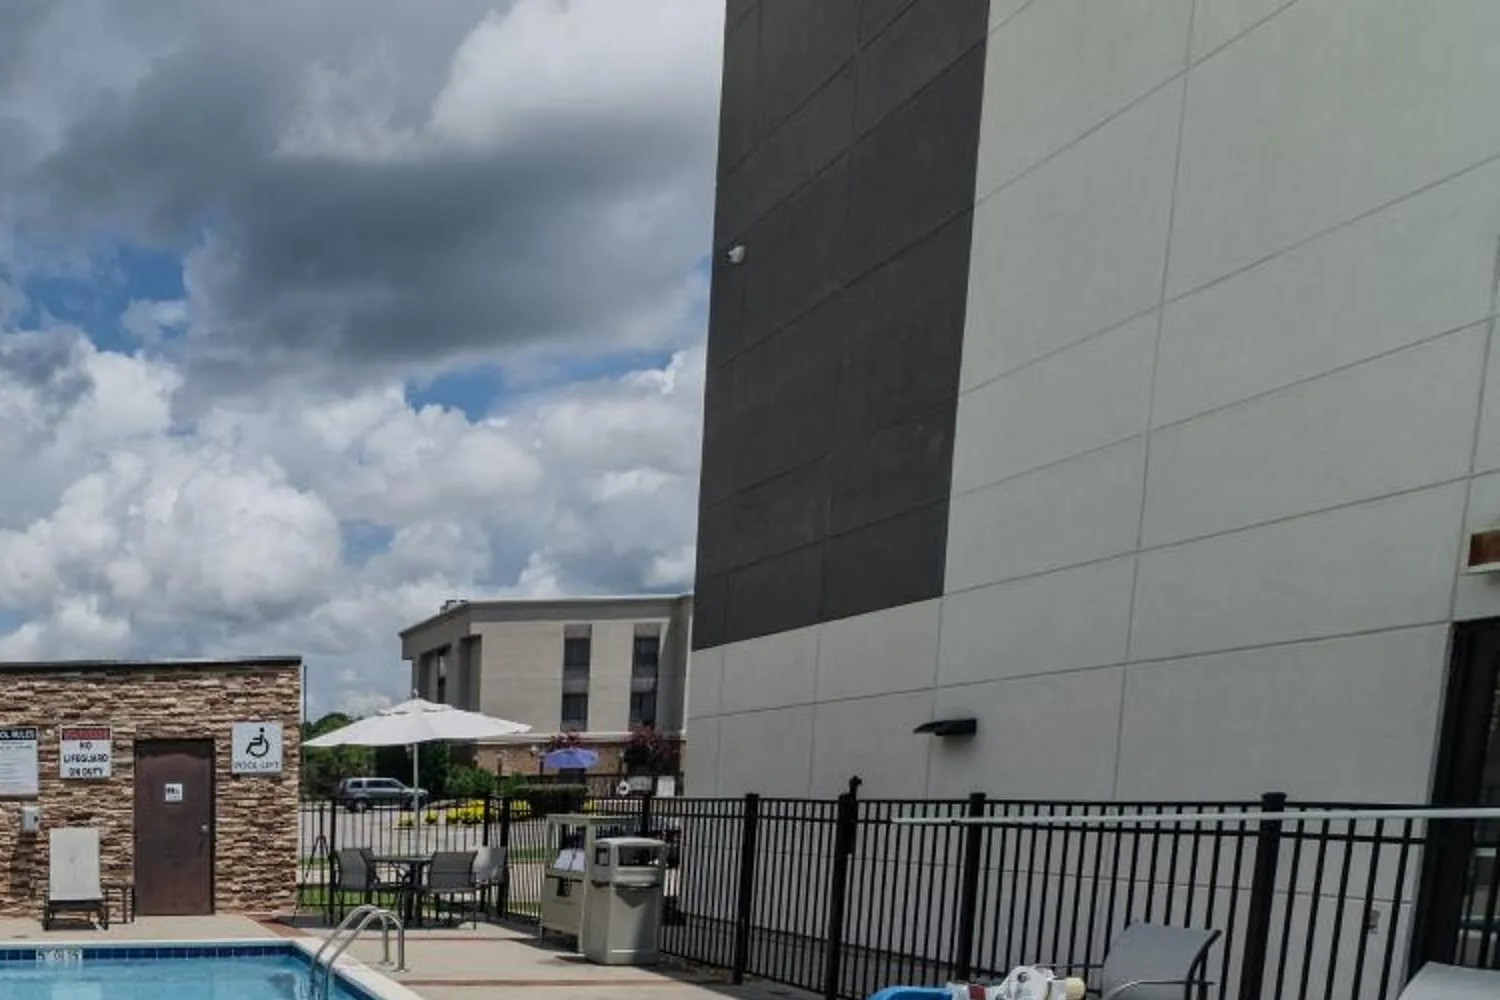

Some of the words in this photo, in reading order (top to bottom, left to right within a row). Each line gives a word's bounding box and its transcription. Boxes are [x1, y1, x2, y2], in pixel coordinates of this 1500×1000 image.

[79, 741, 93, 751] NO
[63, 753, 108, 763] LIFEGUARD
[68, 767, 80, 777] ON
[82, 767, 104, 777] DUTY
